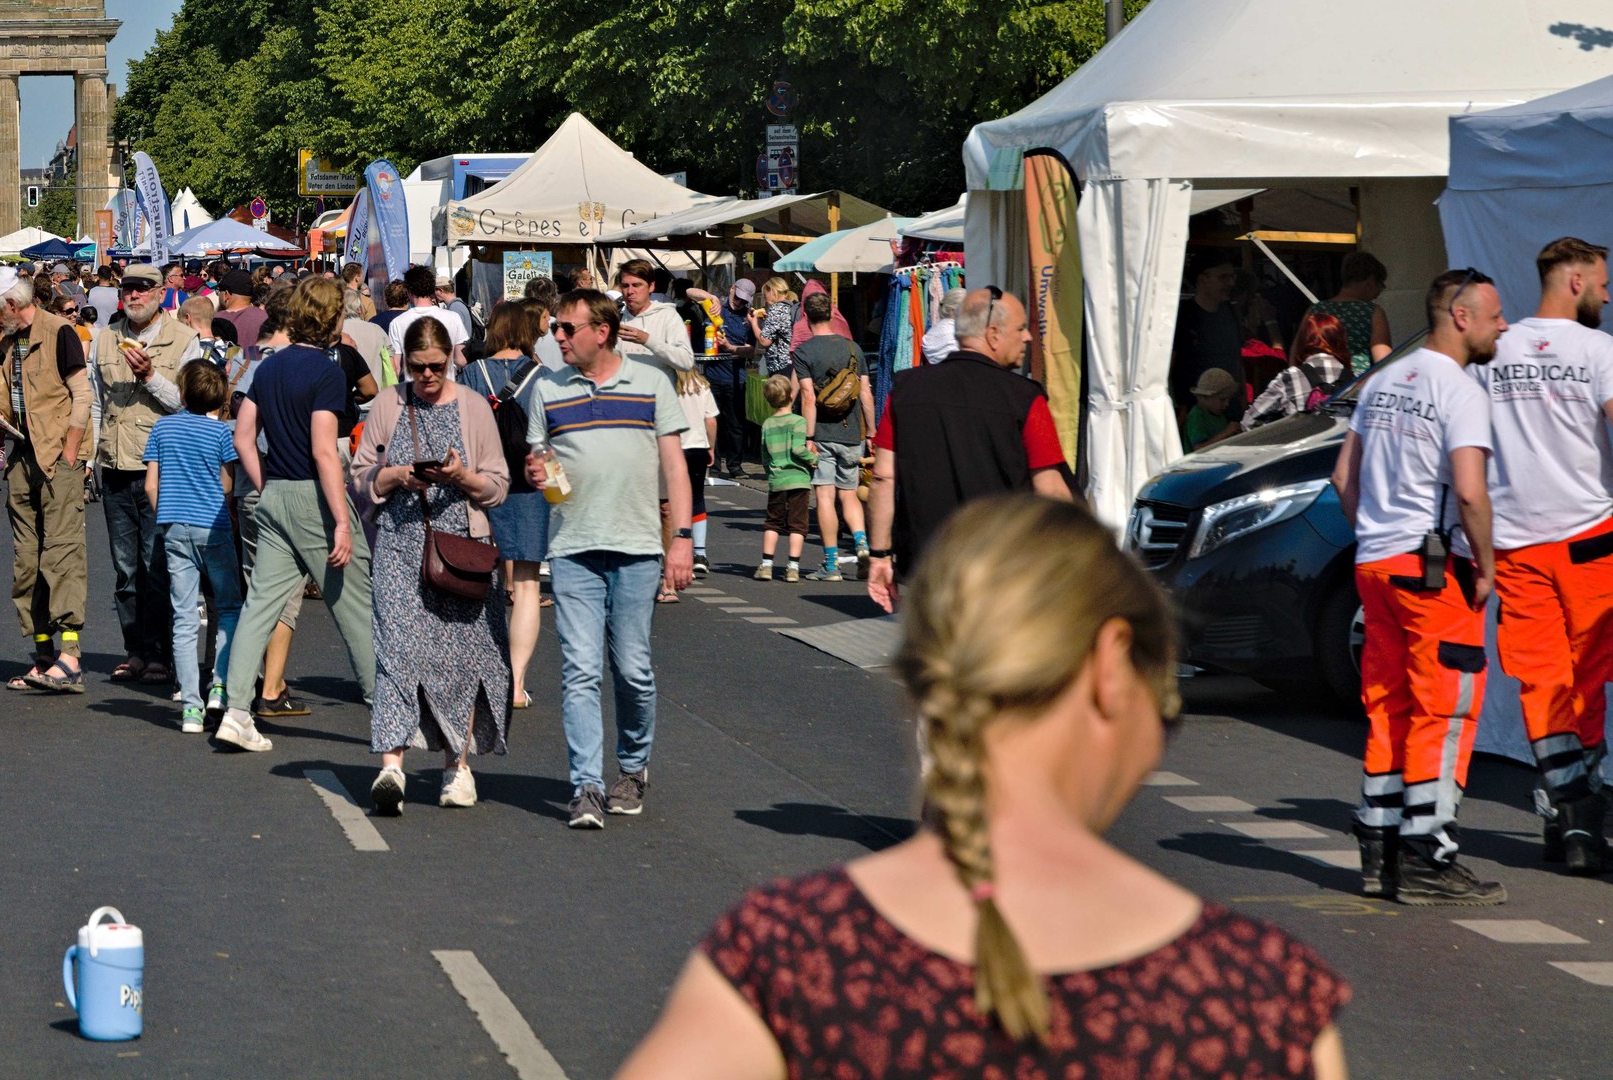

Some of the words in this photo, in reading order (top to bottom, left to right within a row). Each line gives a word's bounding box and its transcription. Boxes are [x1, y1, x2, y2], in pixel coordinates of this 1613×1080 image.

[307, 182, 323, 190] Unter
[325, 182, 335, 190] den
[337, 182, 355, 190] Linden
[479, 208, 562, 238] Crêpes
[578, 218, 605, 237] et
[1491, 363, 1591, 384] MEDICAL
[1492, 381, 1545, 395] SERVICE
